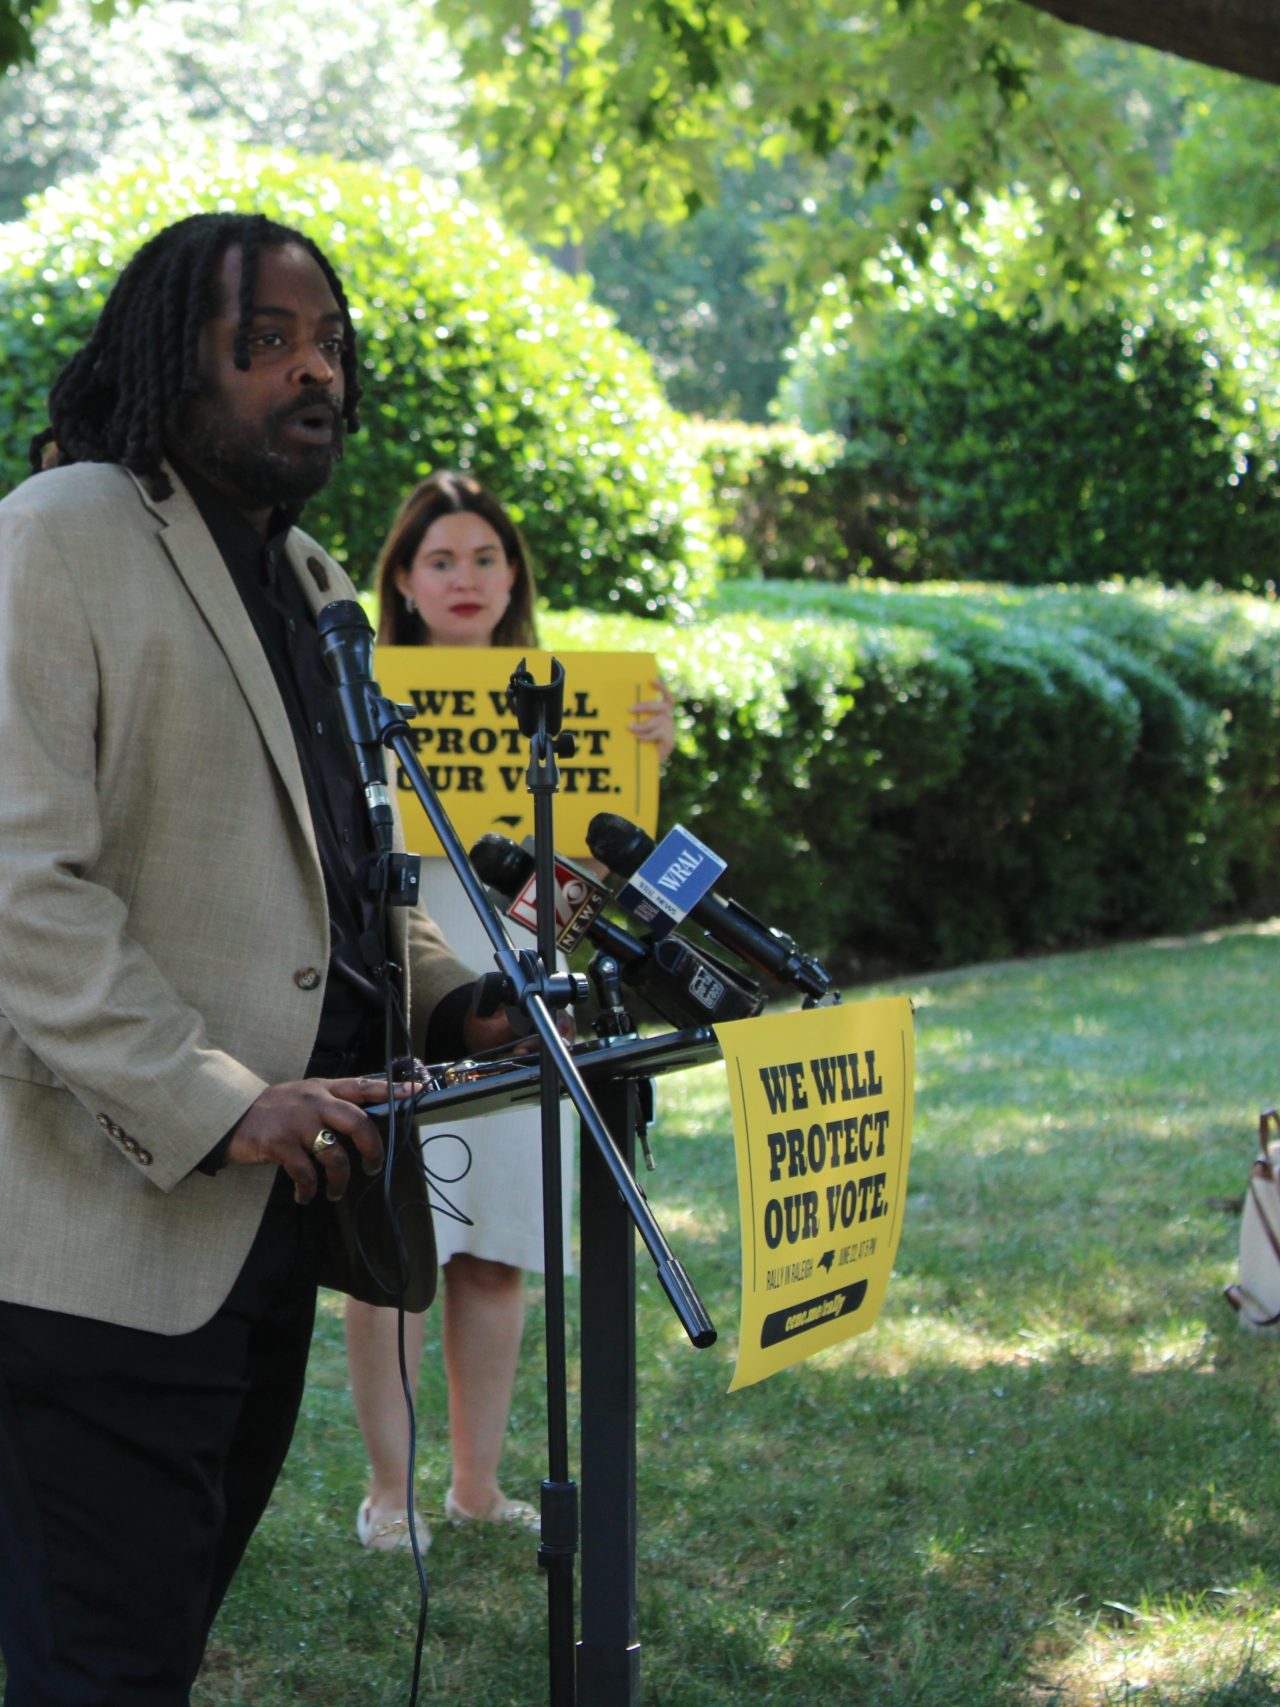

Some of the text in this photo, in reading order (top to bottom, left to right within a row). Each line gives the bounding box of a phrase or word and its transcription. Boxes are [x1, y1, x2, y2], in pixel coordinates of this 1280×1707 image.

[408, 689, 475, 717] WE
[410, 728, 610, 756] PROTT
[498, 766, 621, 793] VTE.
[657, 849, 704, 892] WRAL
[563, 894, 602, 947] NEWS
[656, 896, 678, 916] NEWS
[759, 1050, 883, 1115] WE WILL
[767, 1110, 890, 1182] PROTECT
[764, 1172, 888, 1250] OUR VOTE.
[766, 1267, 784, 1291] RALLY
